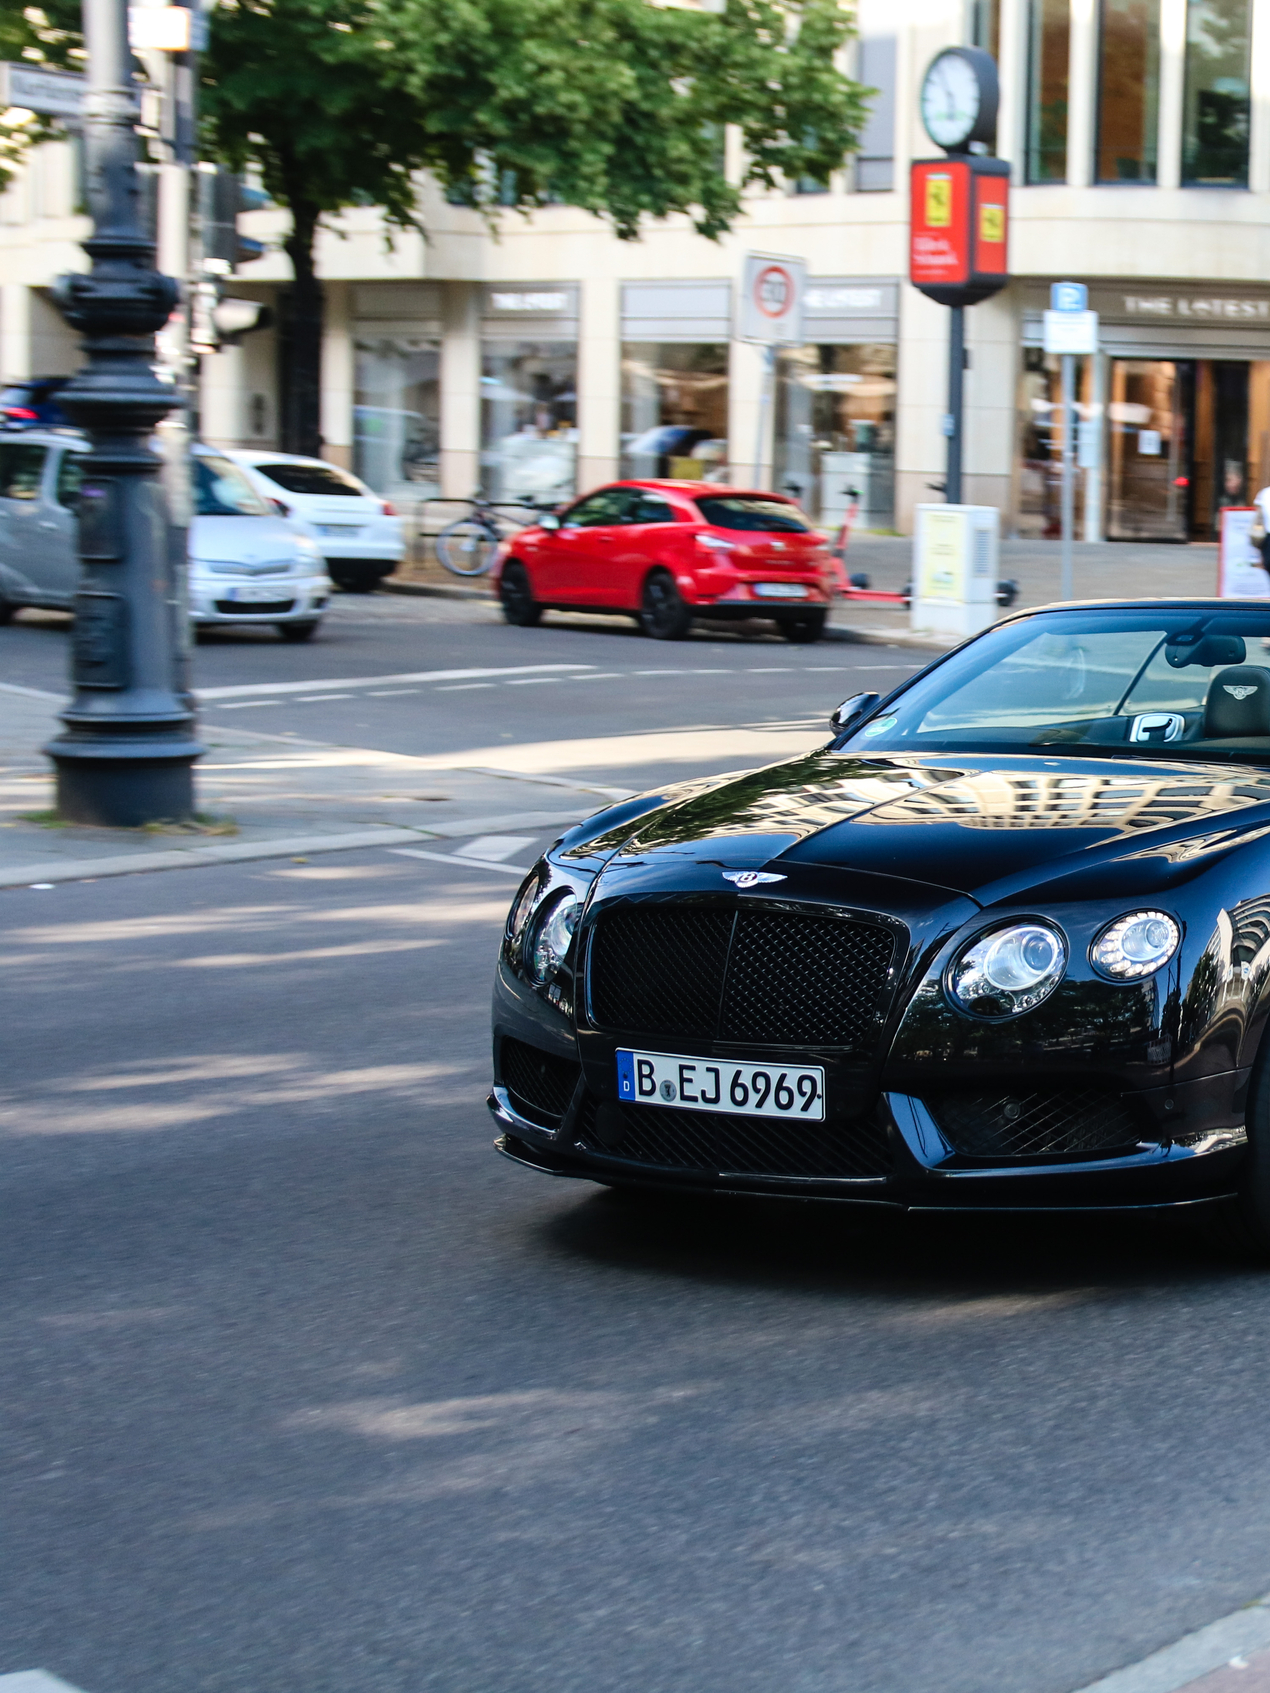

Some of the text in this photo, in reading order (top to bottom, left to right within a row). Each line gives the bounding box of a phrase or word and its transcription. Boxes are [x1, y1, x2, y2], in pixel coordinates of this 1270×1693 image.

[1123, 295, 1270, 318] THE LATEST
[622, 1080, 630, 1092] D
[636, 1058, 818, 1112] B EJ 6969
